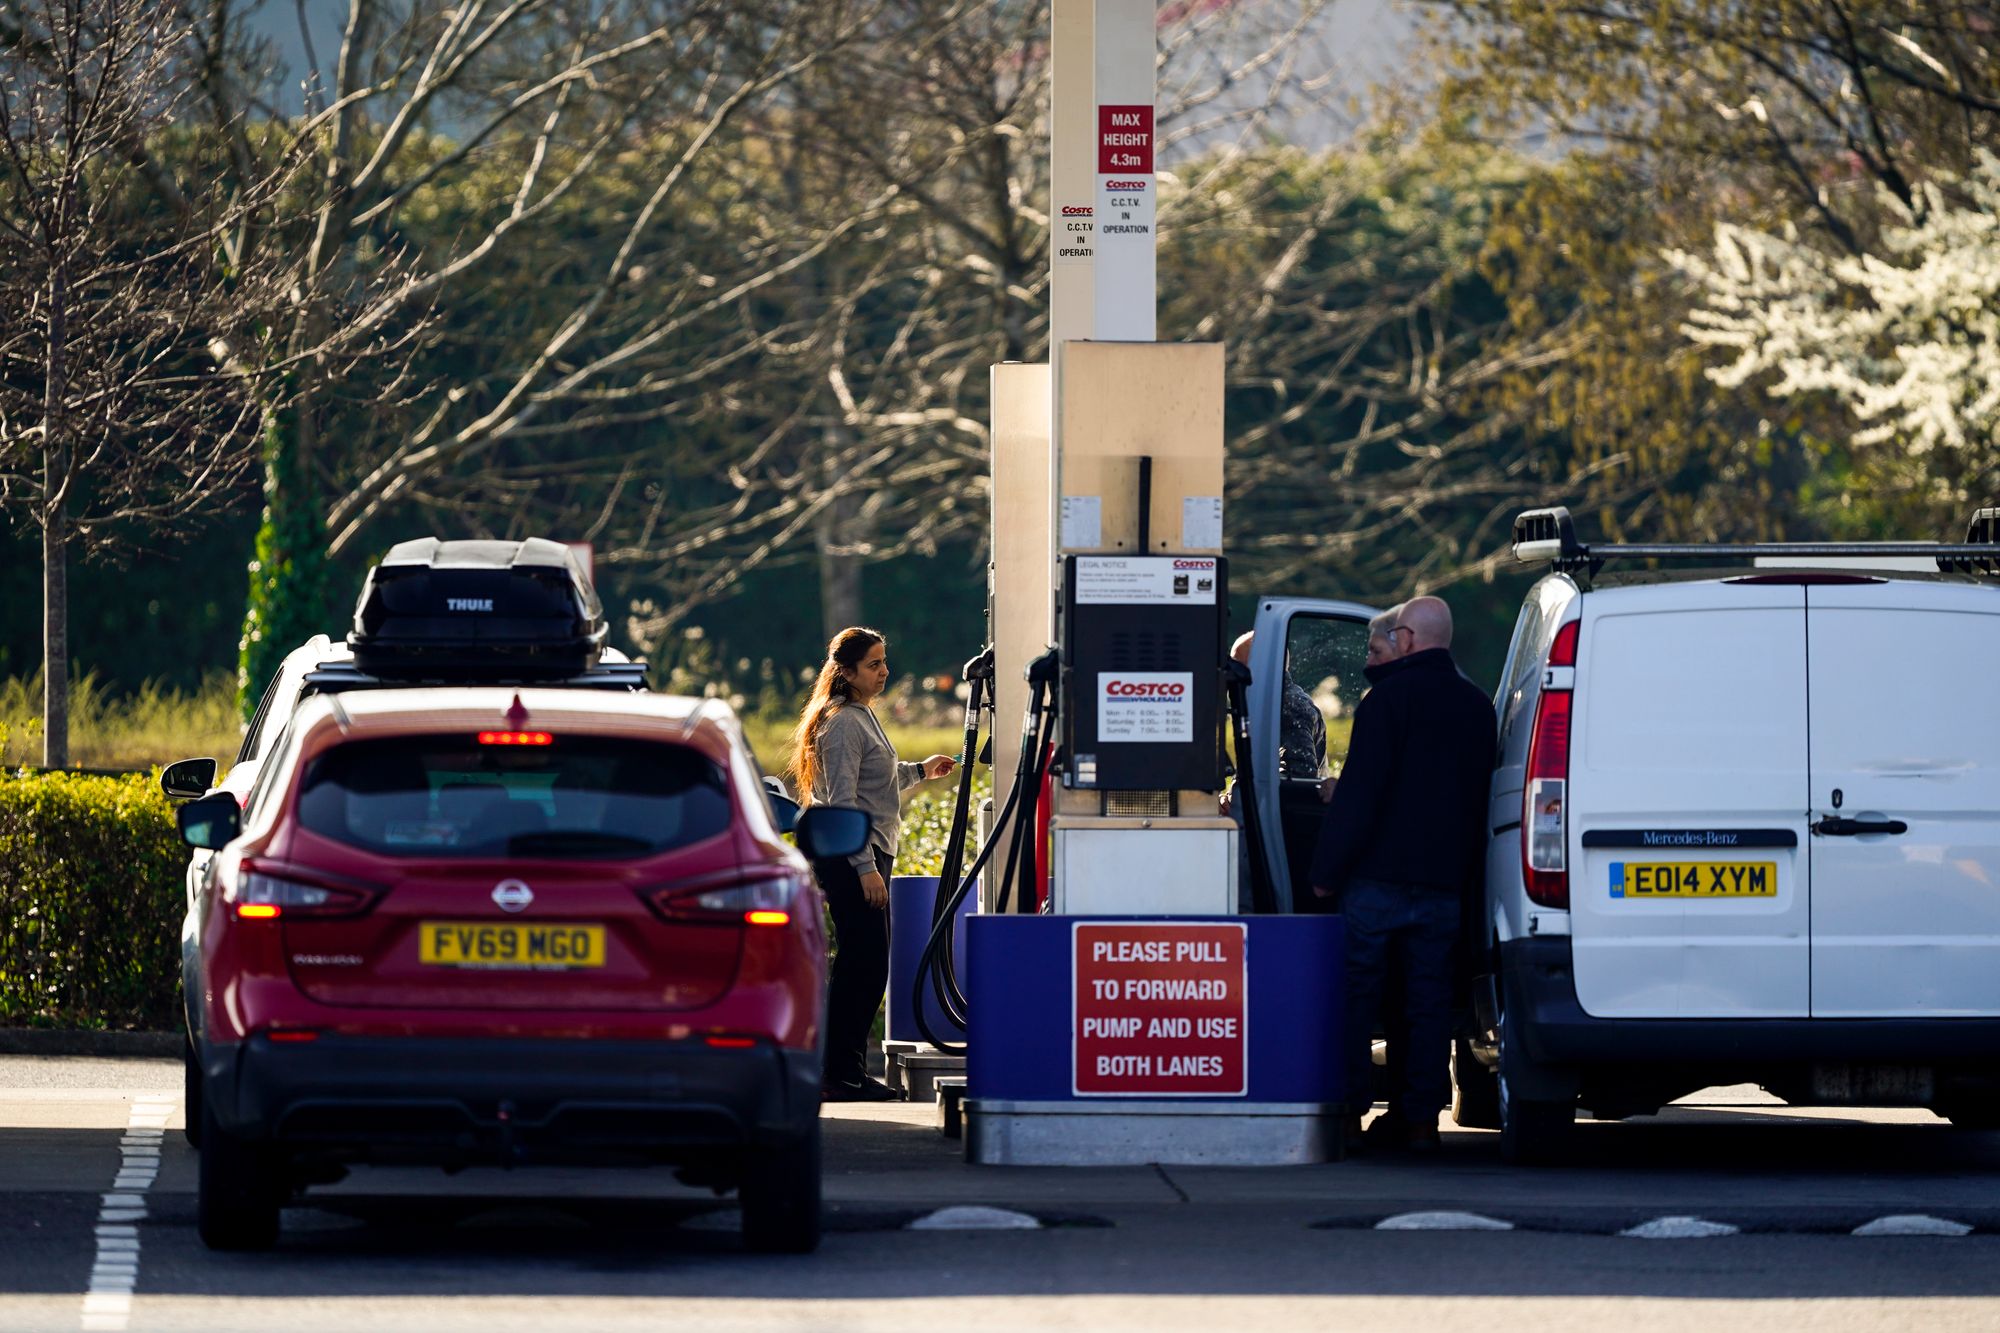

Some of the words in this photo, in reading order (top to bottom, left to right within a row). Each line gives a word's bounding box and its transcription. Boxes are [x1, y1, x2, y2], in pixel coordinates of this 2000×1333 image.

[1112, 113, 1140, 126] MAX
[1104, 133, 1148, 146] HEIGHT
[1110, 153, 1141, 166] 4.3m
[1106, 180, 1146, 188] COSTCO
[1111, 198, 1141, 207] C.C.T.V.
[1062, 206, 1093, 214] COSTC
[1121, 211, 1130, 220] IN
[1103, 225, 1149, 234] OPERATION
[1076, 236, 1085, 244] IN
[1059, 248, 1094, 257] OPERATI
[1079, 561, 1099, 569] LEGAL
[1102, 561, 1128, 569] NOTICE
[1173, 559, 1215, 568] COSTCO
[447, 599, 493, 611] THULE
[1106, 680, 1185, 696] COSTCO
[1106, 718, 1136, 726] Saturday
[1106, 727, 1131, 735] Sunday
[1643, 831, 1738, 845] Mercedes-Benz
[1636, 866, 1700, 892] EO14
[1710, 866, 1767, 892] XYM
[434, 927, 518, 959] FV69
[528, 928, 591, 960] MGO
[1093, 941, 1170, 962] PLEASE
[1176, 941, 1227, 962] PULL
[1092, 980, 1119, 1000] TO
[1124, 980, 1227, 1000] FORWARD
[1083, 1018, 1142, 1038] PUMP
[1147, 1018, 1192, 1038] AND
[1197, 1018, 1237, 1038] USE
[1096, 1056, 1151, 1076] BOTH
[1156, 1056, 1223, 1076] LANES
